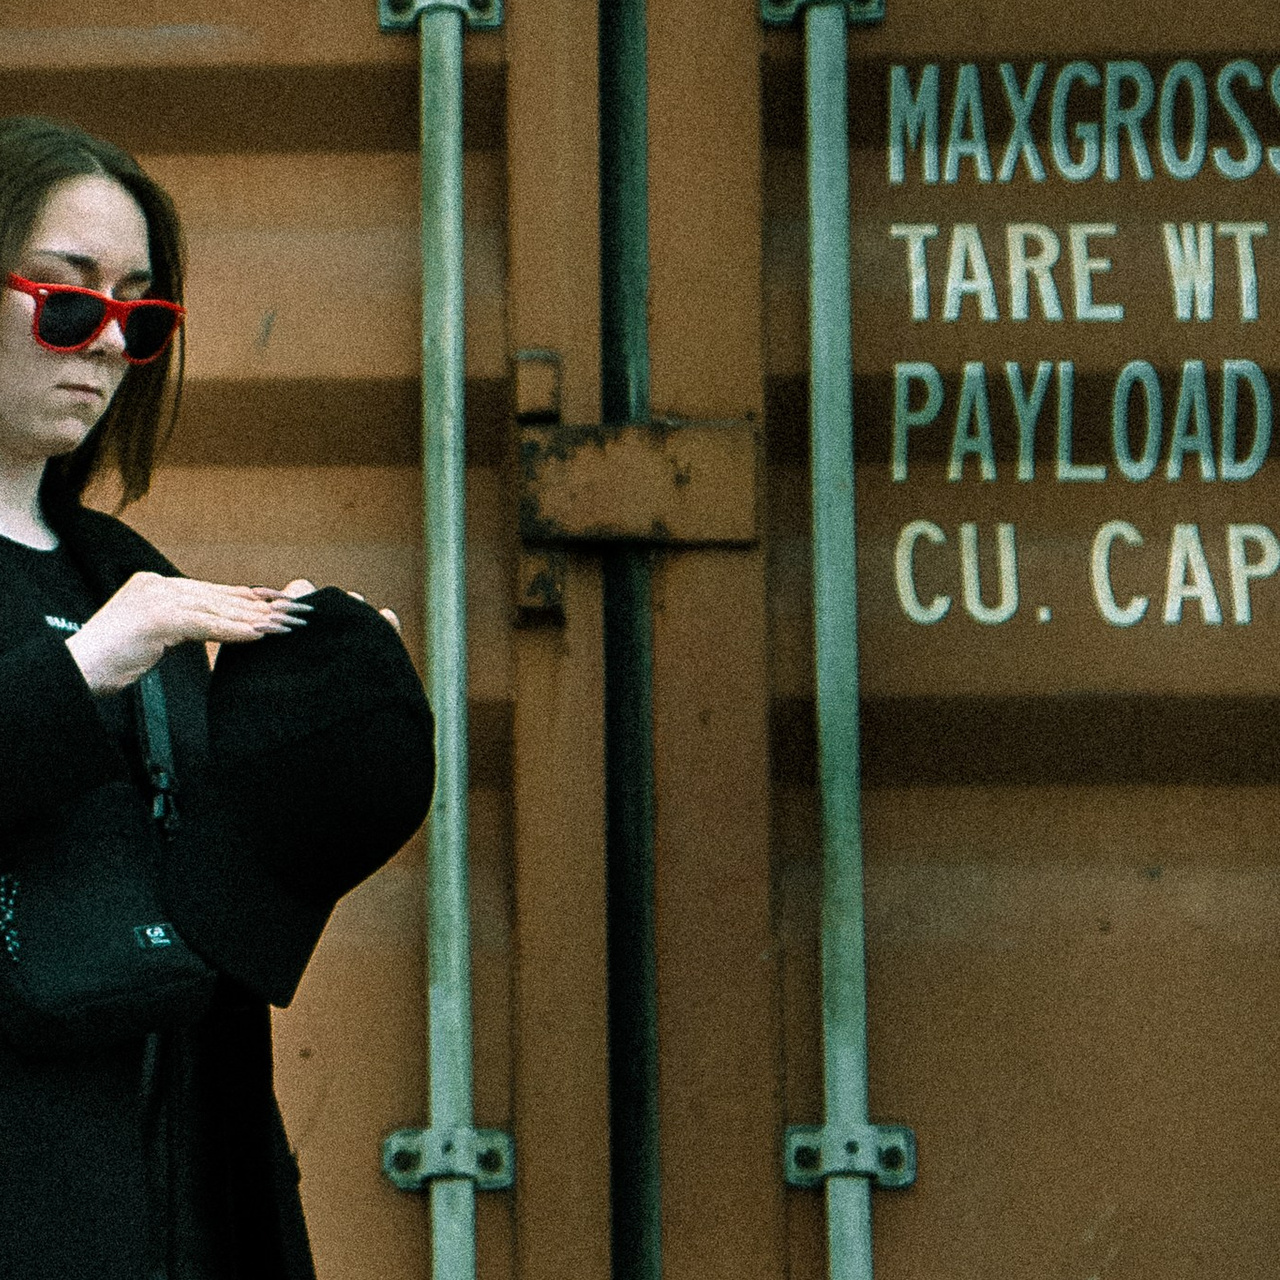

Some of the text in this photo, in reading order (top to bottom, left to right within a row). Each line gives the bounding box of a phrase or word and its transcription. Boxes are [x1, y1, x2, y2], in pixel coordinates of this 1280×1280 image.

[888, 59, 1280, 185] MAXGROS
[890, 222, 1269, 323] TARE WT
[891, 358, 1273, 482] PAYLOAD
[894, 519, 1280, 627] CU. CAP
